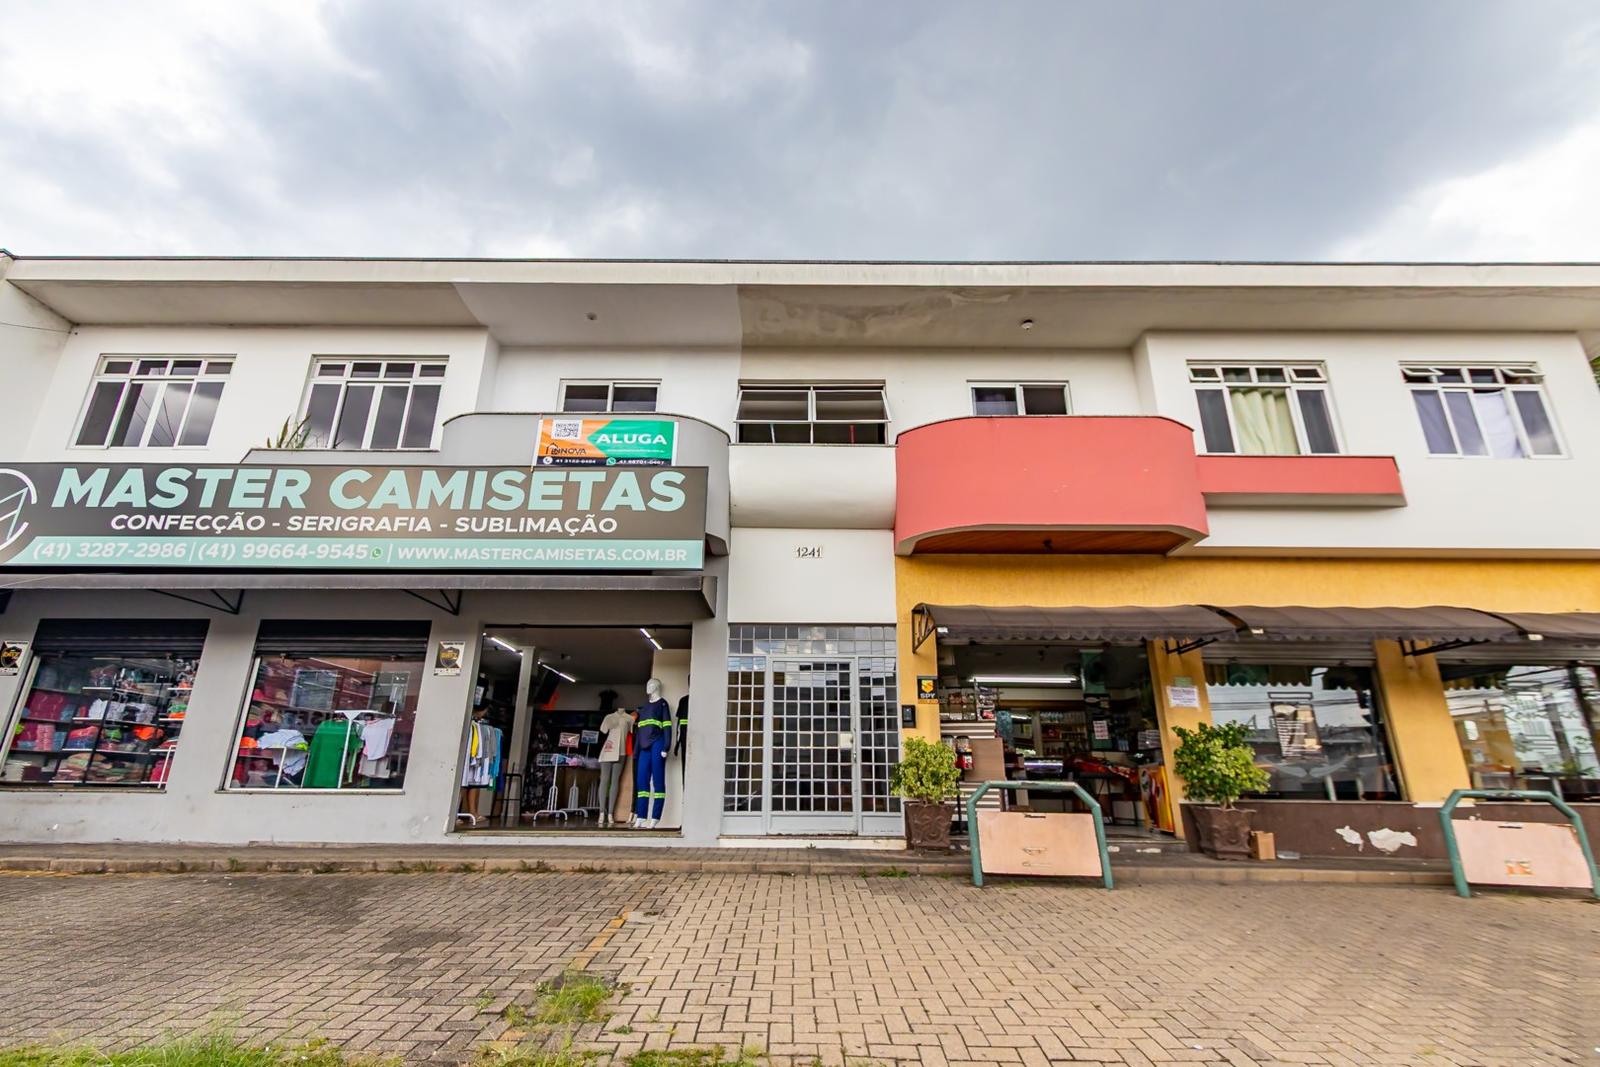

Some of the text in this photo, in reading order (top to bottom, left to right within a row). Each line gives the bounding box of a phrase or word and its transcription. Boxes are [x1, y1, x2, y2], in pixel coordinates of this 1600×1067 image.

[596, 433, 668, 445] ALUGA
[51, 467, 687, 513] MASTER CAMISETAS
[110, 511, 266, 534] CONFECÇÃO
[286, 514, 432, 532] SERIGRAFIA
[454, 514, 618, 536] SUBLIMAÇÃO
[33, 542, 72, 560] (41)
[76, 542, 187, 558] 3287-2986
[198, 543, 236, 561] (41)
[242, 543, 369, 559] 99664-9545
[397, 546, 688, 562] WWW.MASTERCAMISETAS.COM.BR
[797, 546, 821, 558] 1241
